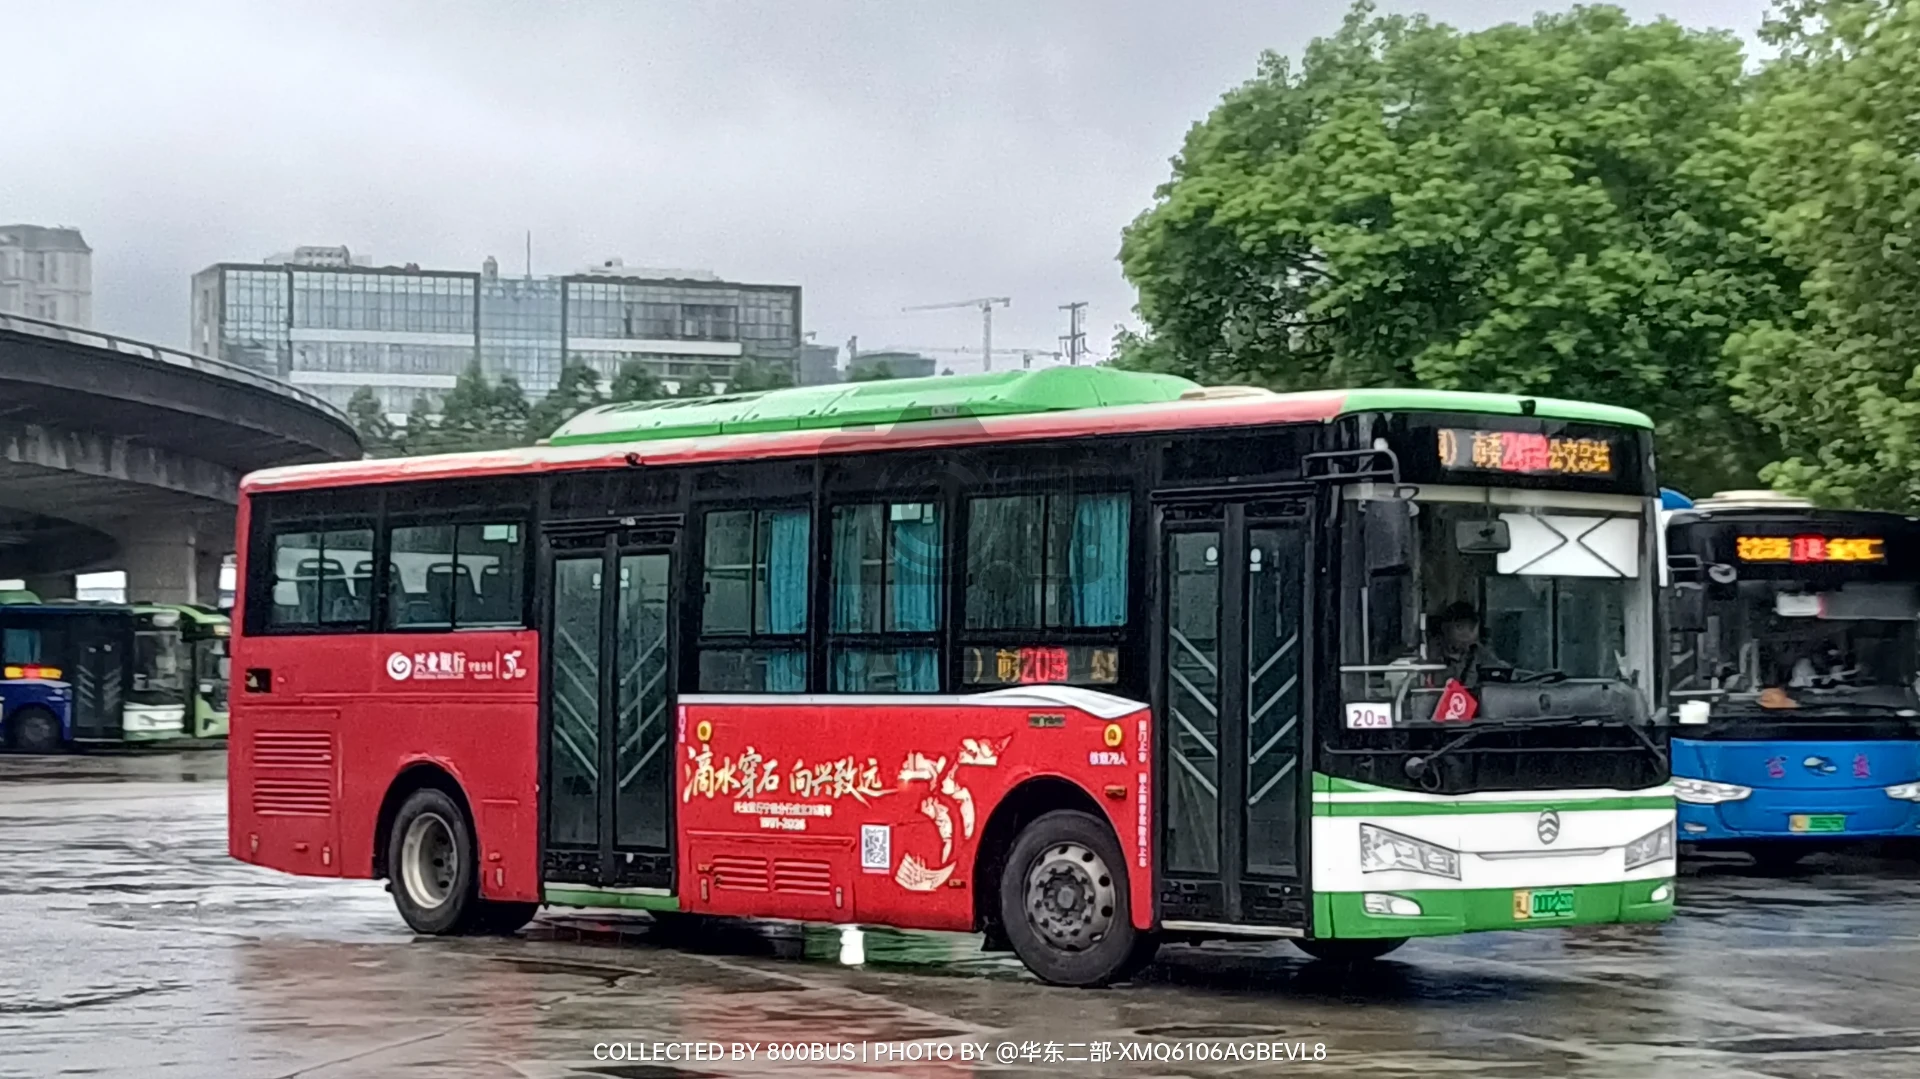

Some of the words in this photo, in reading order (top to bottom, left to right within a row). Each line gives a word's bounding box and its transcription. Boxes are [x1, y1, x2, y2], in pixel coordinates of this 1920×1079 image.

[683, 743, 780, 804] 滴水穿石
[789, 755, 898, 809] 向兴致远
